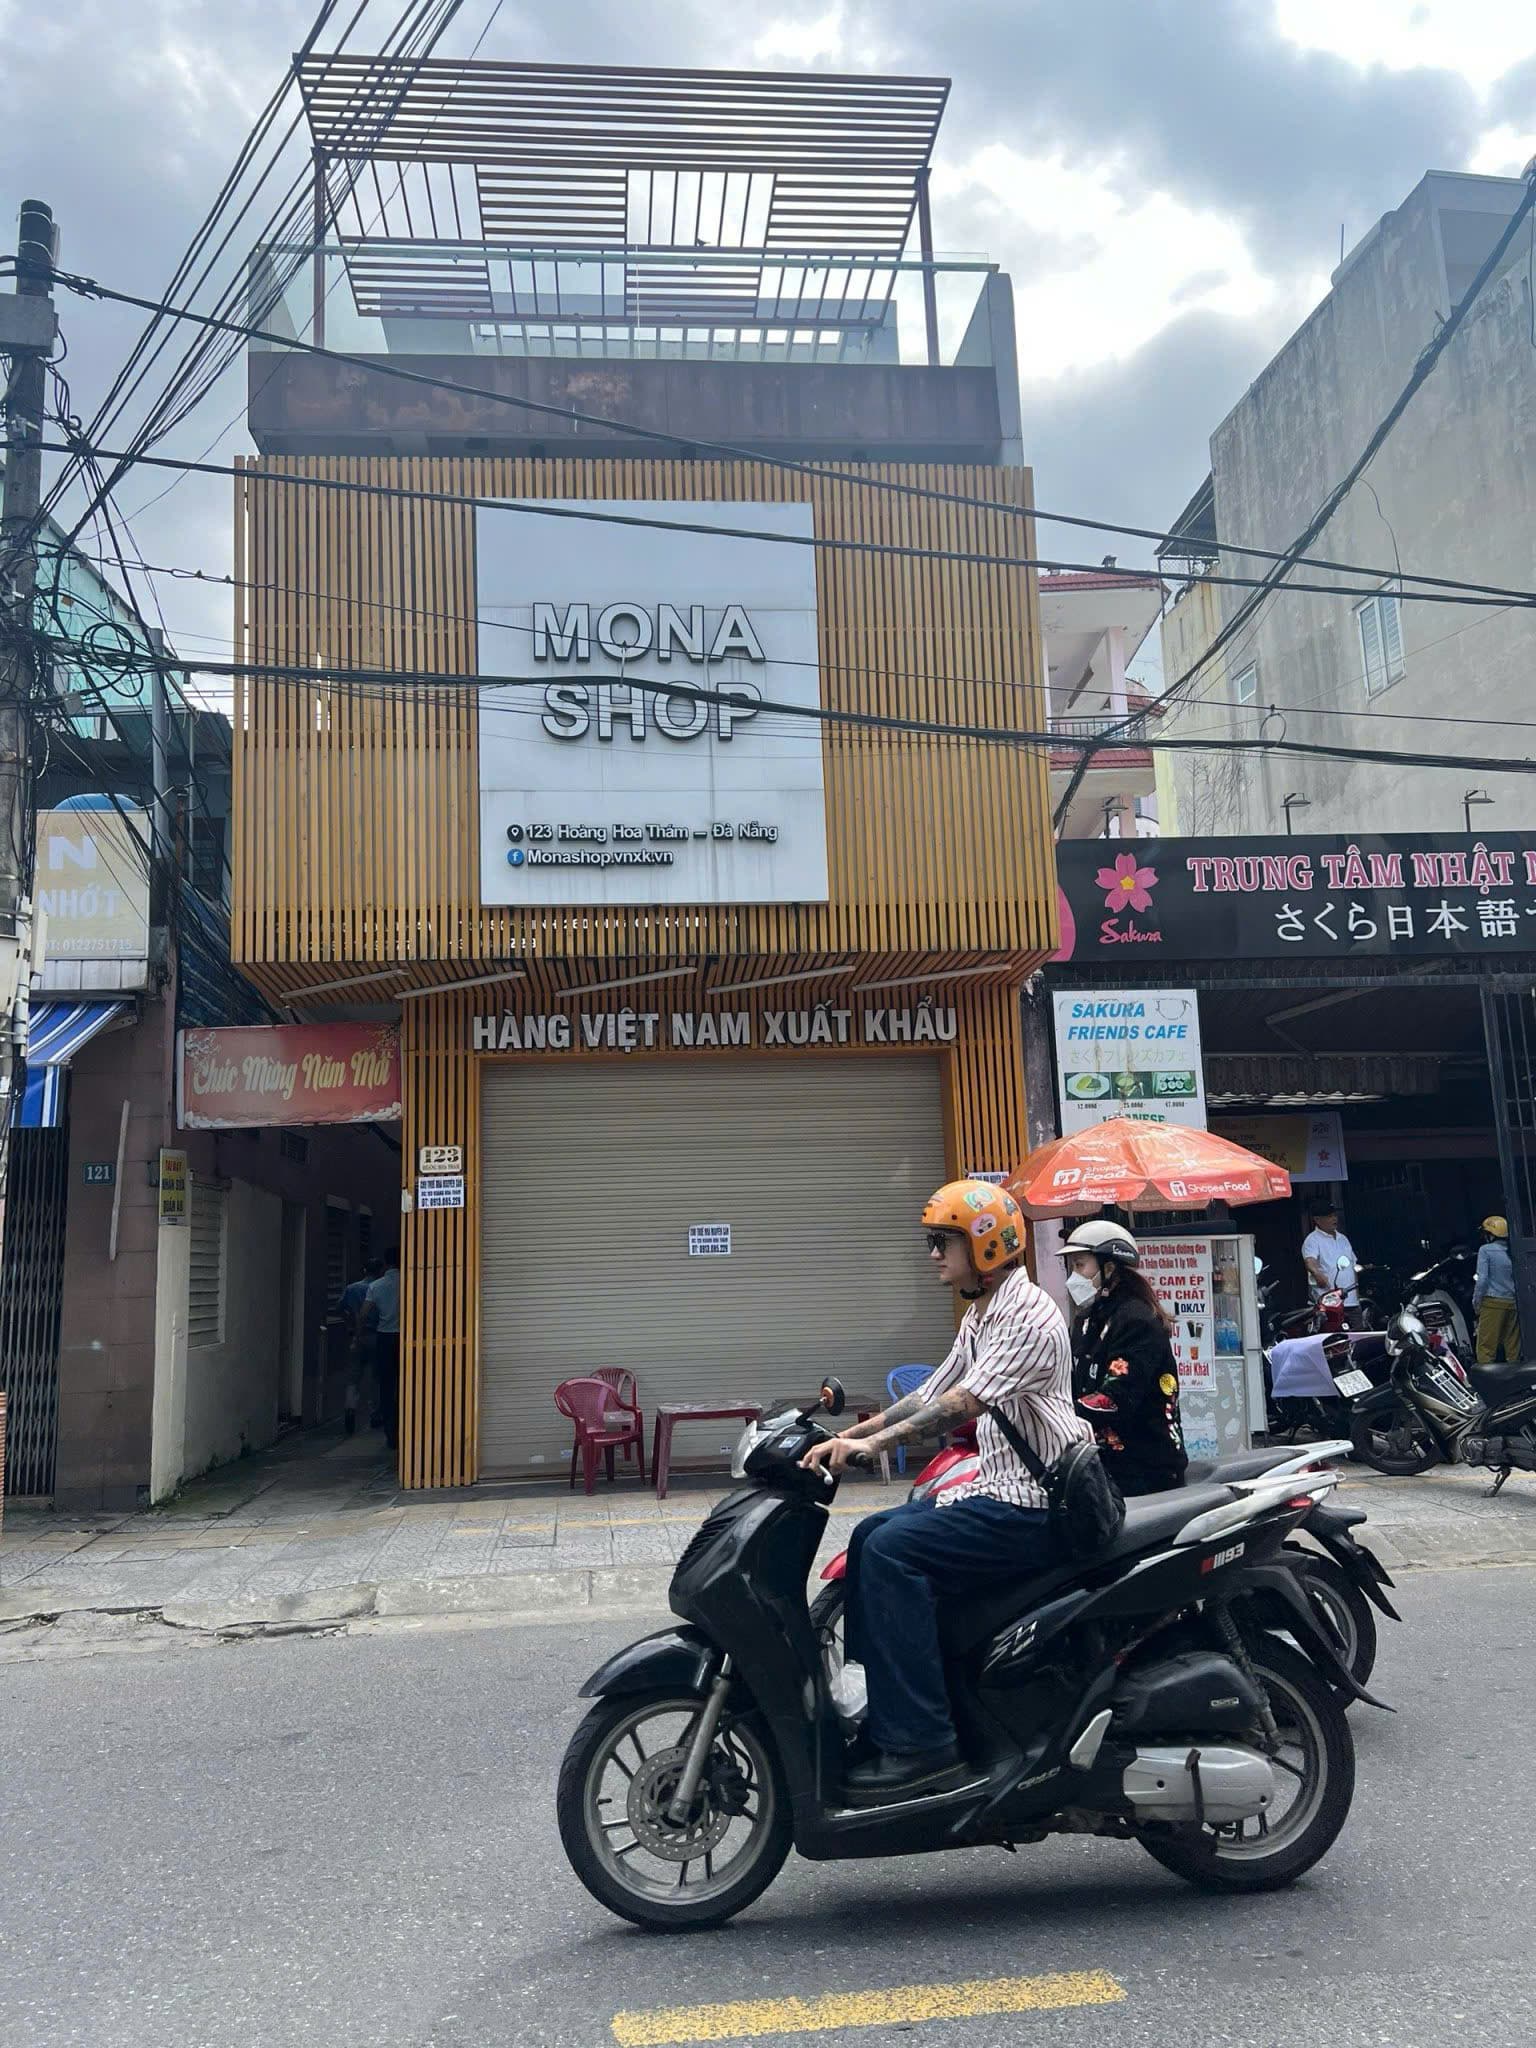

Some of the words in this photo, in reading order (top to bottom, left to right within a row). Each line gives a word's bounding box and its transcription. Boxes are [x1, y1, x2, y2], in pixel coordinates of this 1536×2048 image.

[532, 602, 766, 662] MONA
[542, 681, 763, 741] SHOP
[527, 824, 552, 839] 123
[558, 824, 607, 843] Hoàng
[612, 825, 643, 839] Hoa
[647, 823, 688, 839] Thám
[712, 823, 733, 839] Đà
[738, 821, 778, 843] Nẵng
[527, 849, 674, 868] Monashop.vnxk.vn
[1187, 853, 1314, 893] TRUNG
[1320, 843, 1406, 889] TÂM
[1410, 842, 1515, 895] NHẬT
[1099, 918, 1163, 944] Sakura
[1071, 1003, 1146, 1018] SAKURA
[473, 1010, 571, 1050] HÀNG
[581, 1007, 659, 1054] VIỆT
[672, 1011, 751, 1047] NAM
[763, 999, 853, 1046] XUẤT
[865, 996, 958, 1043] KHẨU
[1067, 1025, 1140, 1040] FRIENDS
[1144, 1024, 1188, 1039] CAFE
[193, 1058, 238, 1095] Chúc
[243, 1056, 298, 1100] Mừng
[302, 1053, 346, 1092] Năm
[424, 1148, 460, 1163] 123
[87, 1165, 110, 1180] 121
[1187, 1180, 1251, 1194] ShopeeFood
[1160, 1276, 1185, 1286] CAM
